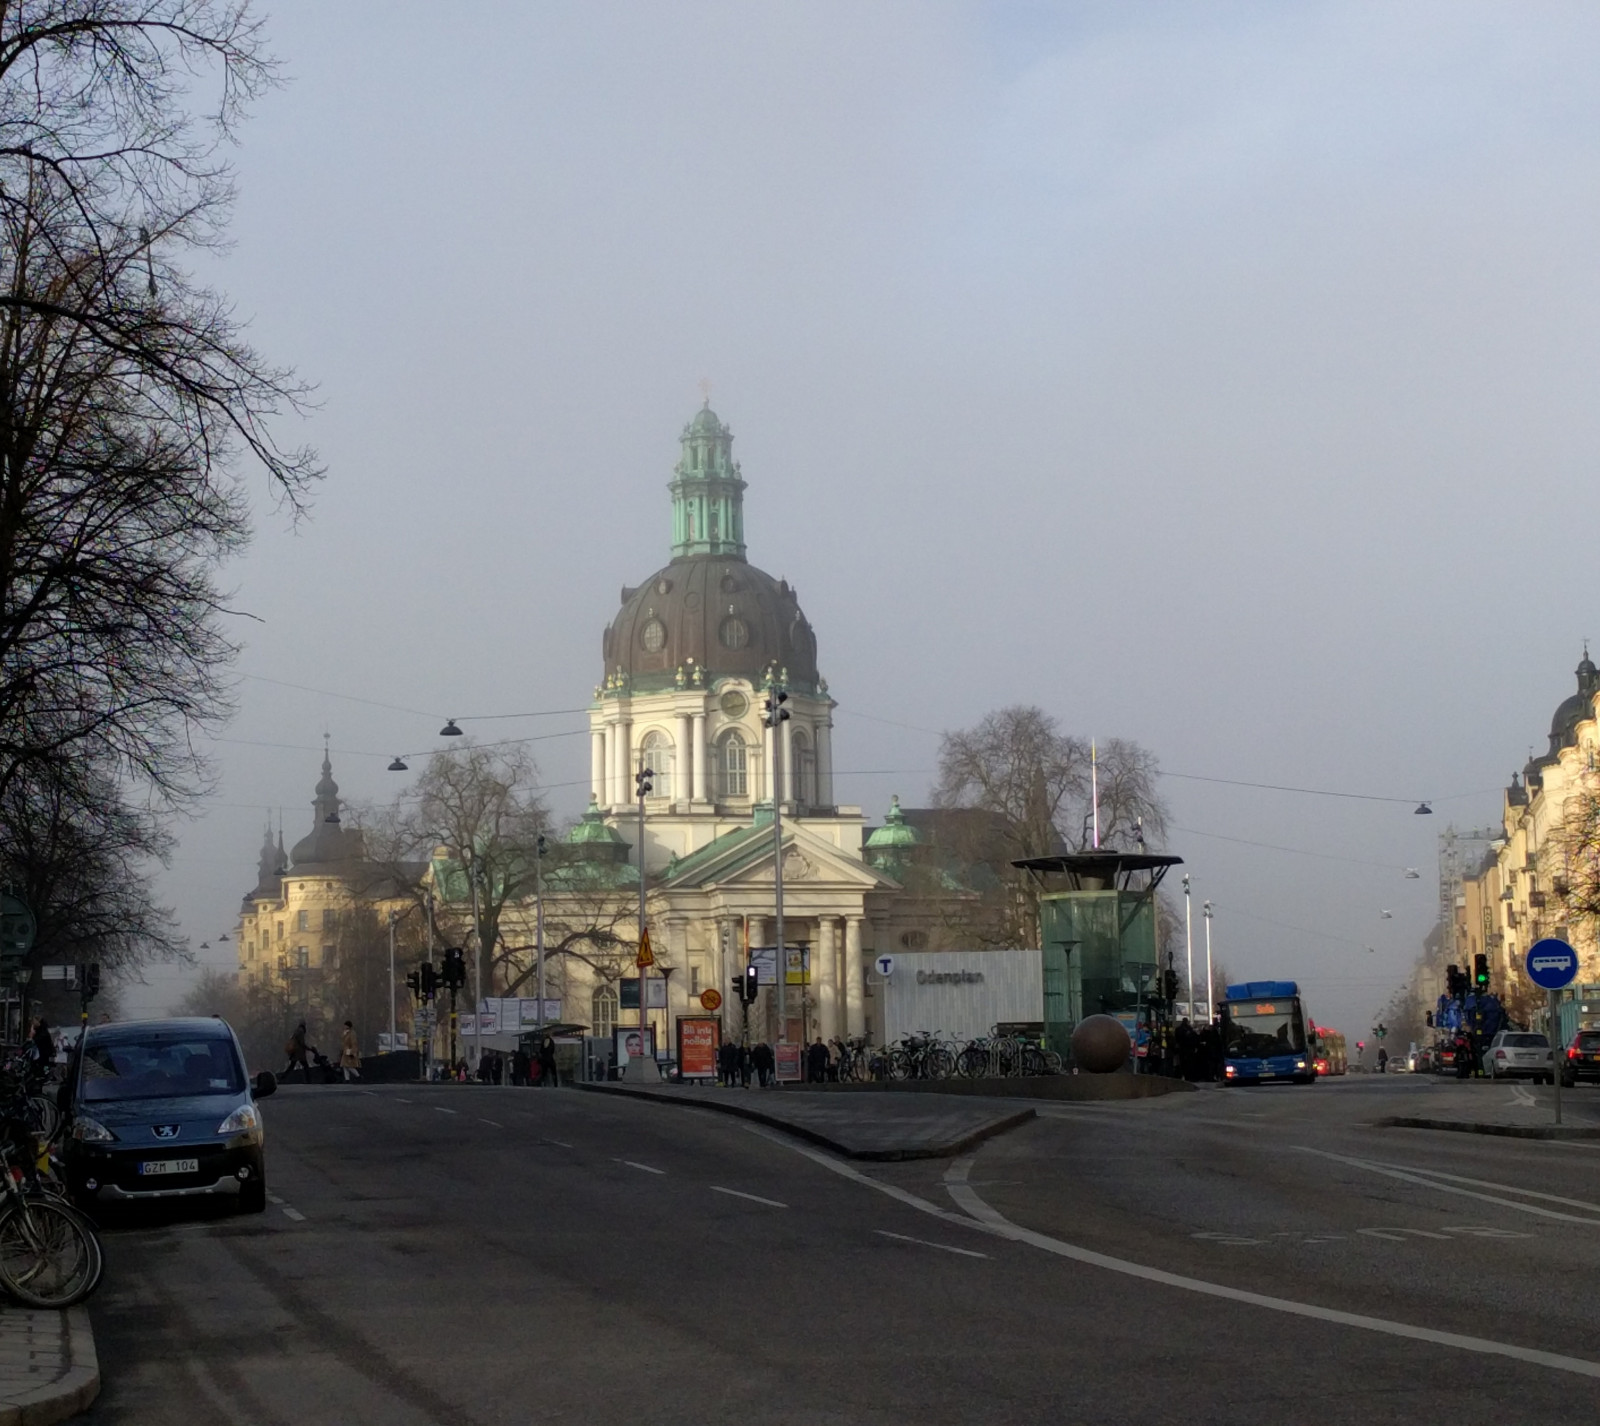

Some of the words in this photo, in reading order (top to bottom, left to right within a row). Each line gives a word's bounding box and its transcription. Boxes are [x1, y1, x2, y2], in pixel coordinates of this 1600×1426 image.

[1484, 908, 1492, 943] HOTEL
[879, 959, 891, 973] T
[916, 969, 984, 986] Odenplan
[144, 1162, 167, 1174] GZM
[176, 1161, 196, 1172] 104
